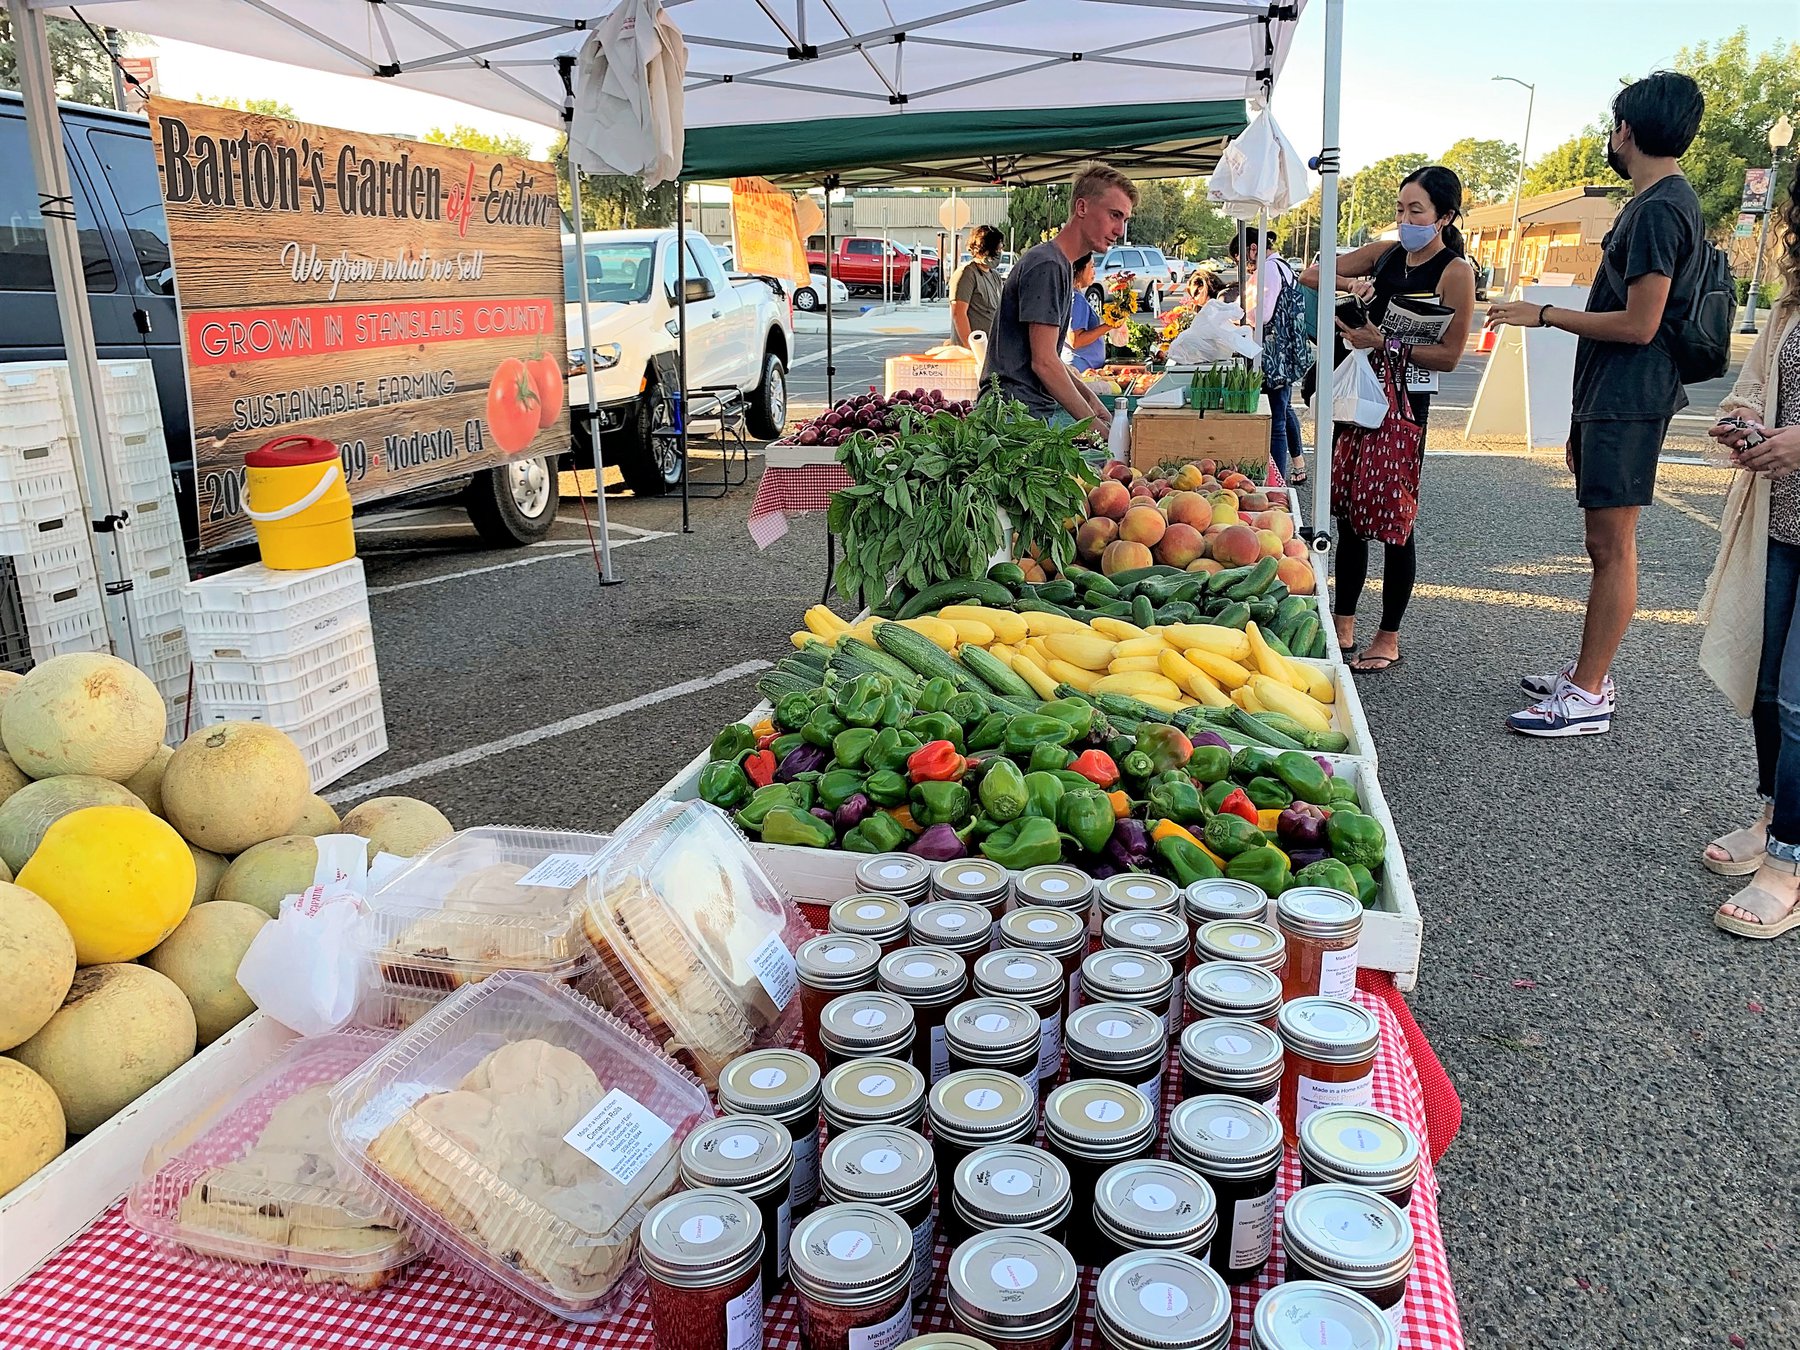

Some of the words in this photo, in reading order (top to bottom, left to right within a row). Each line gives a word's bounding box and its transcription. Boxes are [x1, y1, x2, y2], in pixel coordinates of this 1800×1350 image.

[158, 116, 325, 214] Barton's
[336, 144, 443, 222] Garden
[447, 160, 479, 238] of
[280, 242, 324, 282] We
[328, 250, 379, 301] grow
[383, 247, 430, 282] what
[431, 256, 454, 282] we
[200, 318, 314, 358] GROWN
[324, 313, 344, 346] IN
[354, 306, 466, 344] STANISLAUS
[473, 304, 546, 334] COUNTY
[234, 380, 366, 432] SUSTAINABLE
[377, 370, 456, 408] FARMING
[384, 425, 460, 473] Modesto,
[464, 419, 485, 453] CA
[577, 1126, 588, 1137] Made
[587, 1116, 611, 1139] Cinnamon
[608, 1105, 622, 1118] Rolls
[846, 1237, 864, 1258] Strawberry
[868, 1331, 886, 1341] Made
